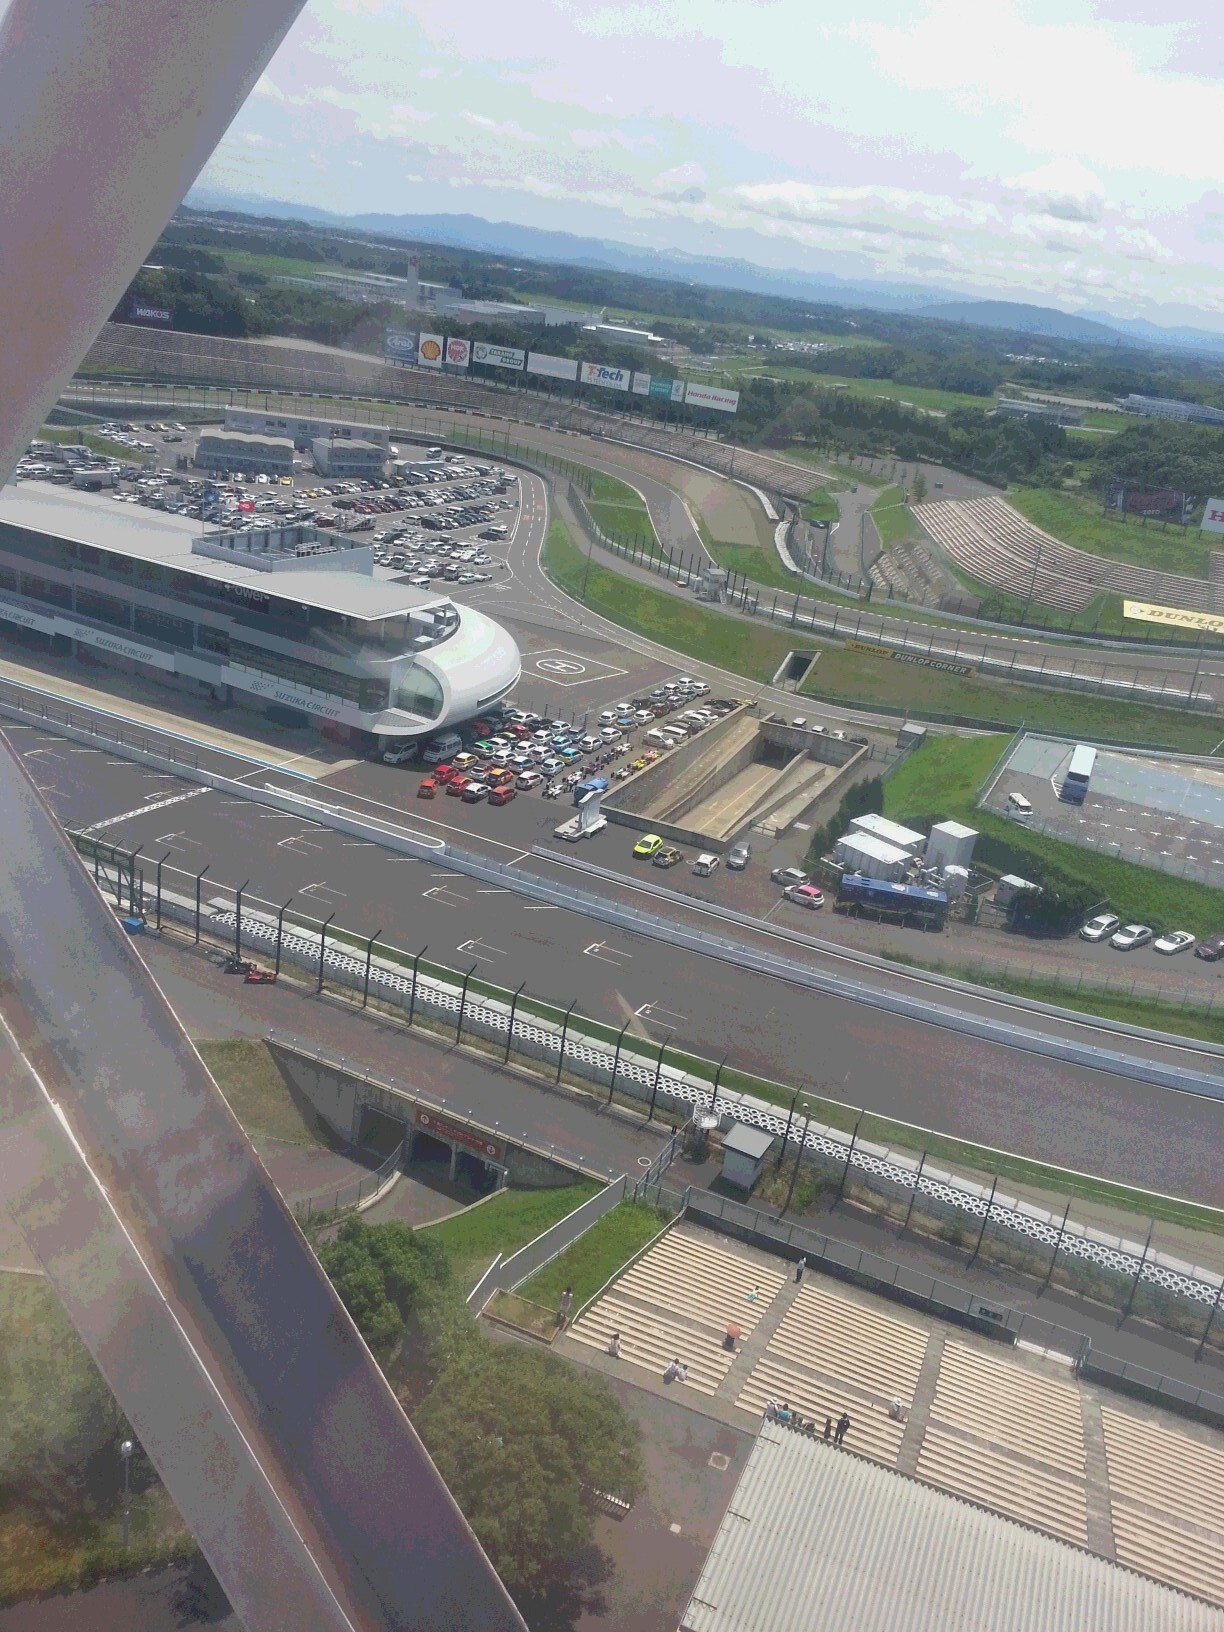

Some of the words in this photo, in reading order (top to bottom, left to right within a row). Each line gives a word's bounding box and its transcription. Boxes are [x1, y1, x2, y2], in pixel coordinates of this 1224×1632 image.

[687, 390, 711, 400] Honda
[711, 395, 737, 406] Racing
[1147, 609, 1224, 627] DUNLO
[95, 636, 124, 654] SUZUKA
[123, 645, 153, 661] CIRCUIT
[854, 643, 889, 656] DUNLOP
[894, 653, 930, 666] DUNLOP
[930, 660, 968, 674] CORNER
[274, 690, 306, 709] SUZUKA
[306, 698, 341, 718] CIRCUIT
